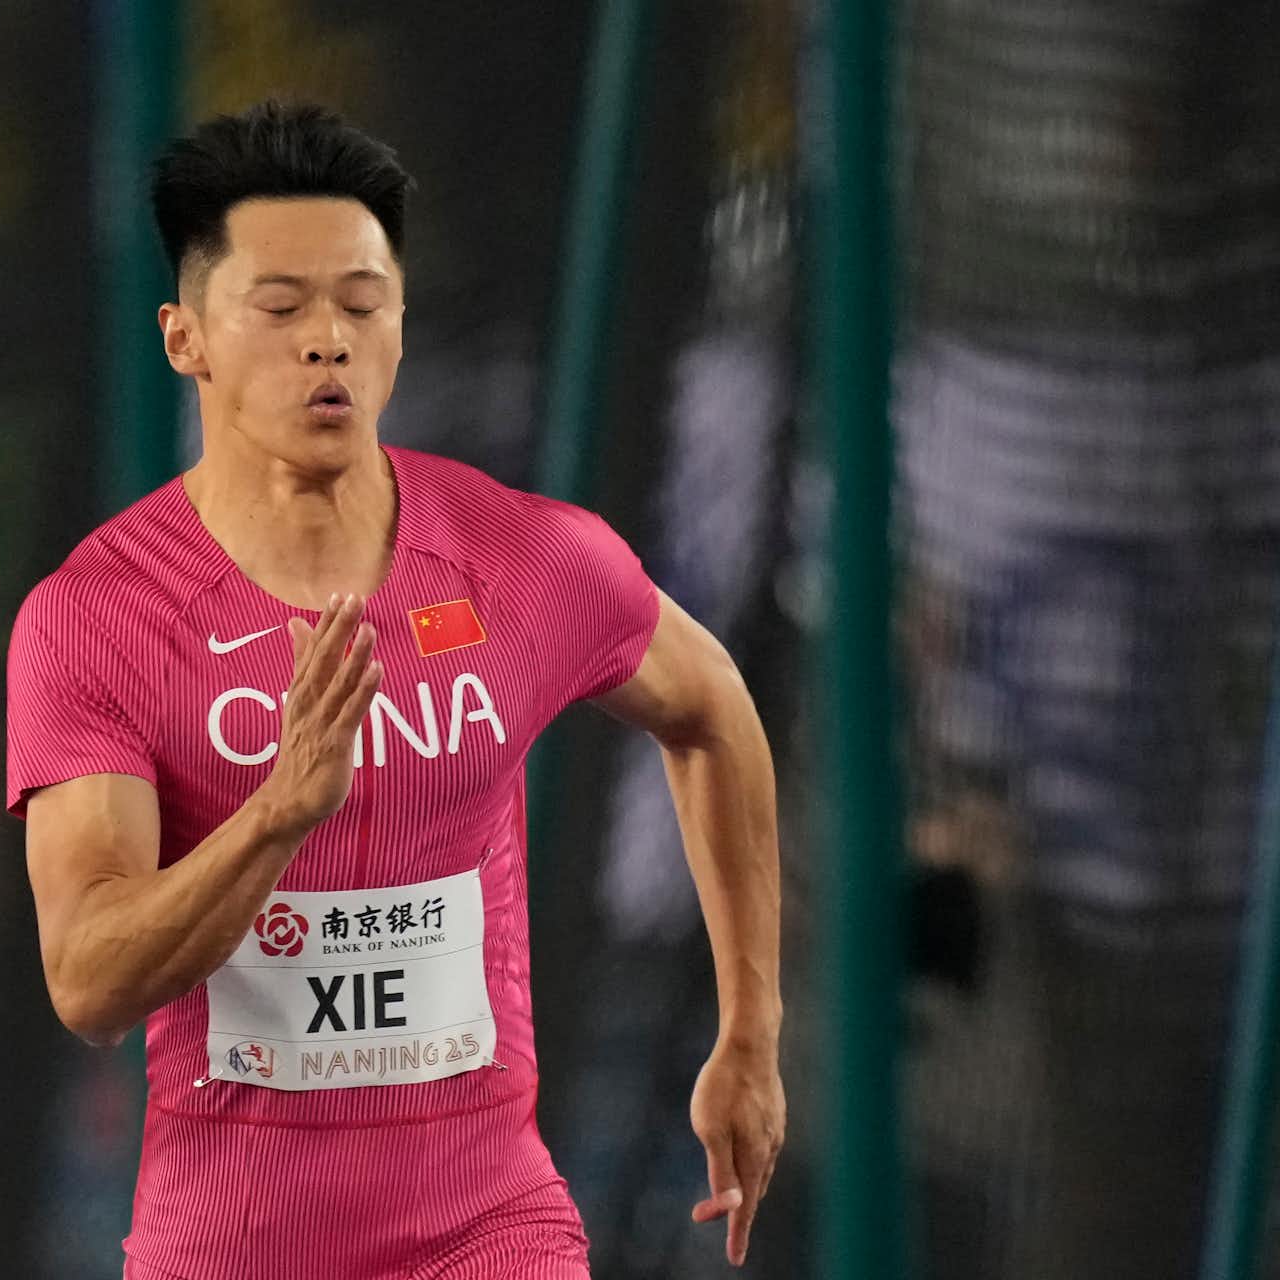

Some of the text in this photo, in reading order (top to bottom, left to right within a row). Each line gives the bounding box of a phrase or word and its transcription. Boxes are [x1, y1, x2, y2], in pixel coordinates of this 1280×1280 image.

[321, 897, 446, 940] 南京银行
[323, 933, 446, 954] BANK OF NANJING
[305, 969, 407, 1034] XIE
[301, 1040, 439, 1080] NANJING
[446, 1033, 480, 1059] 25
